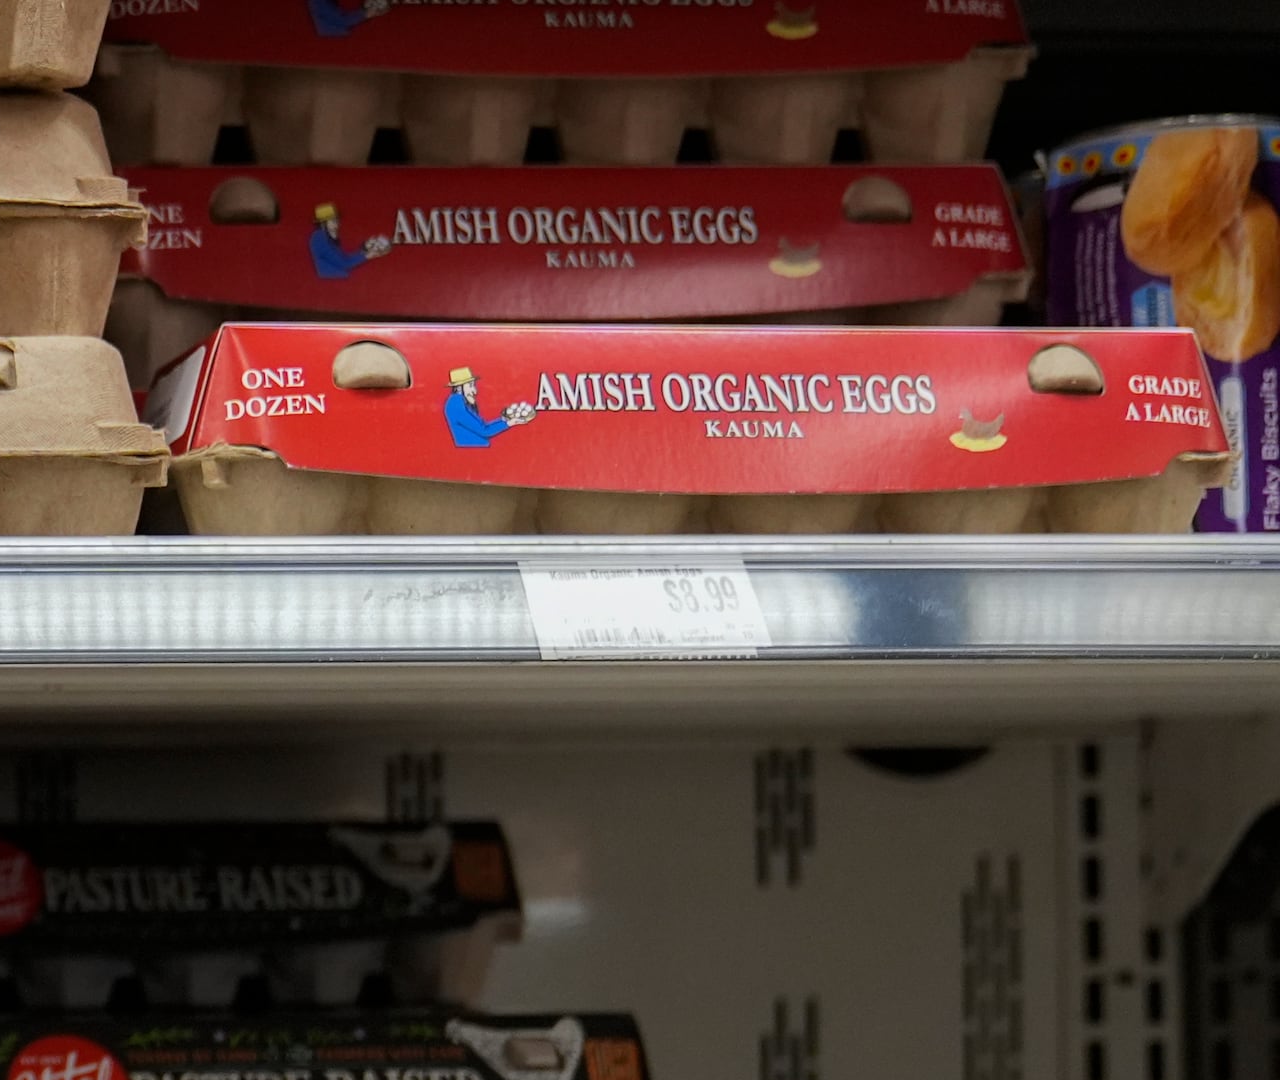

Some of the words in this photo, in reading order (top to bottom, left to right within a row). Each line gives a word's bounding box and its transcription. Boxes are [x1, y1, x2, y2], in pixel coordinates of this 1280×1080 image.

[544, 11, 635, 28] KAUMA
[393, 207, 501, 245] AMISH
[507, 207, 666, 245] ORGANIC
[671, 207, 758, 244] EGGS
[545, 251, 636, 268] KAUMA
[241, 367, 304, 390] ONE
[1128, 376, 1202, 400] GRADE
[536, 372, 657, 413] AMISH
[662, 373, 834, 414] ORGANIC
[842, 374, 937, 415] EGGS
[223, 394, 326, 421] DOZEN
[1125, 402, 1141, 421] A
[1144, 404, 1212, 428] LARGE
[705, 420, 804, 439] KAUMA
[43, 865, 364, 914] PASTURE-RAISED
